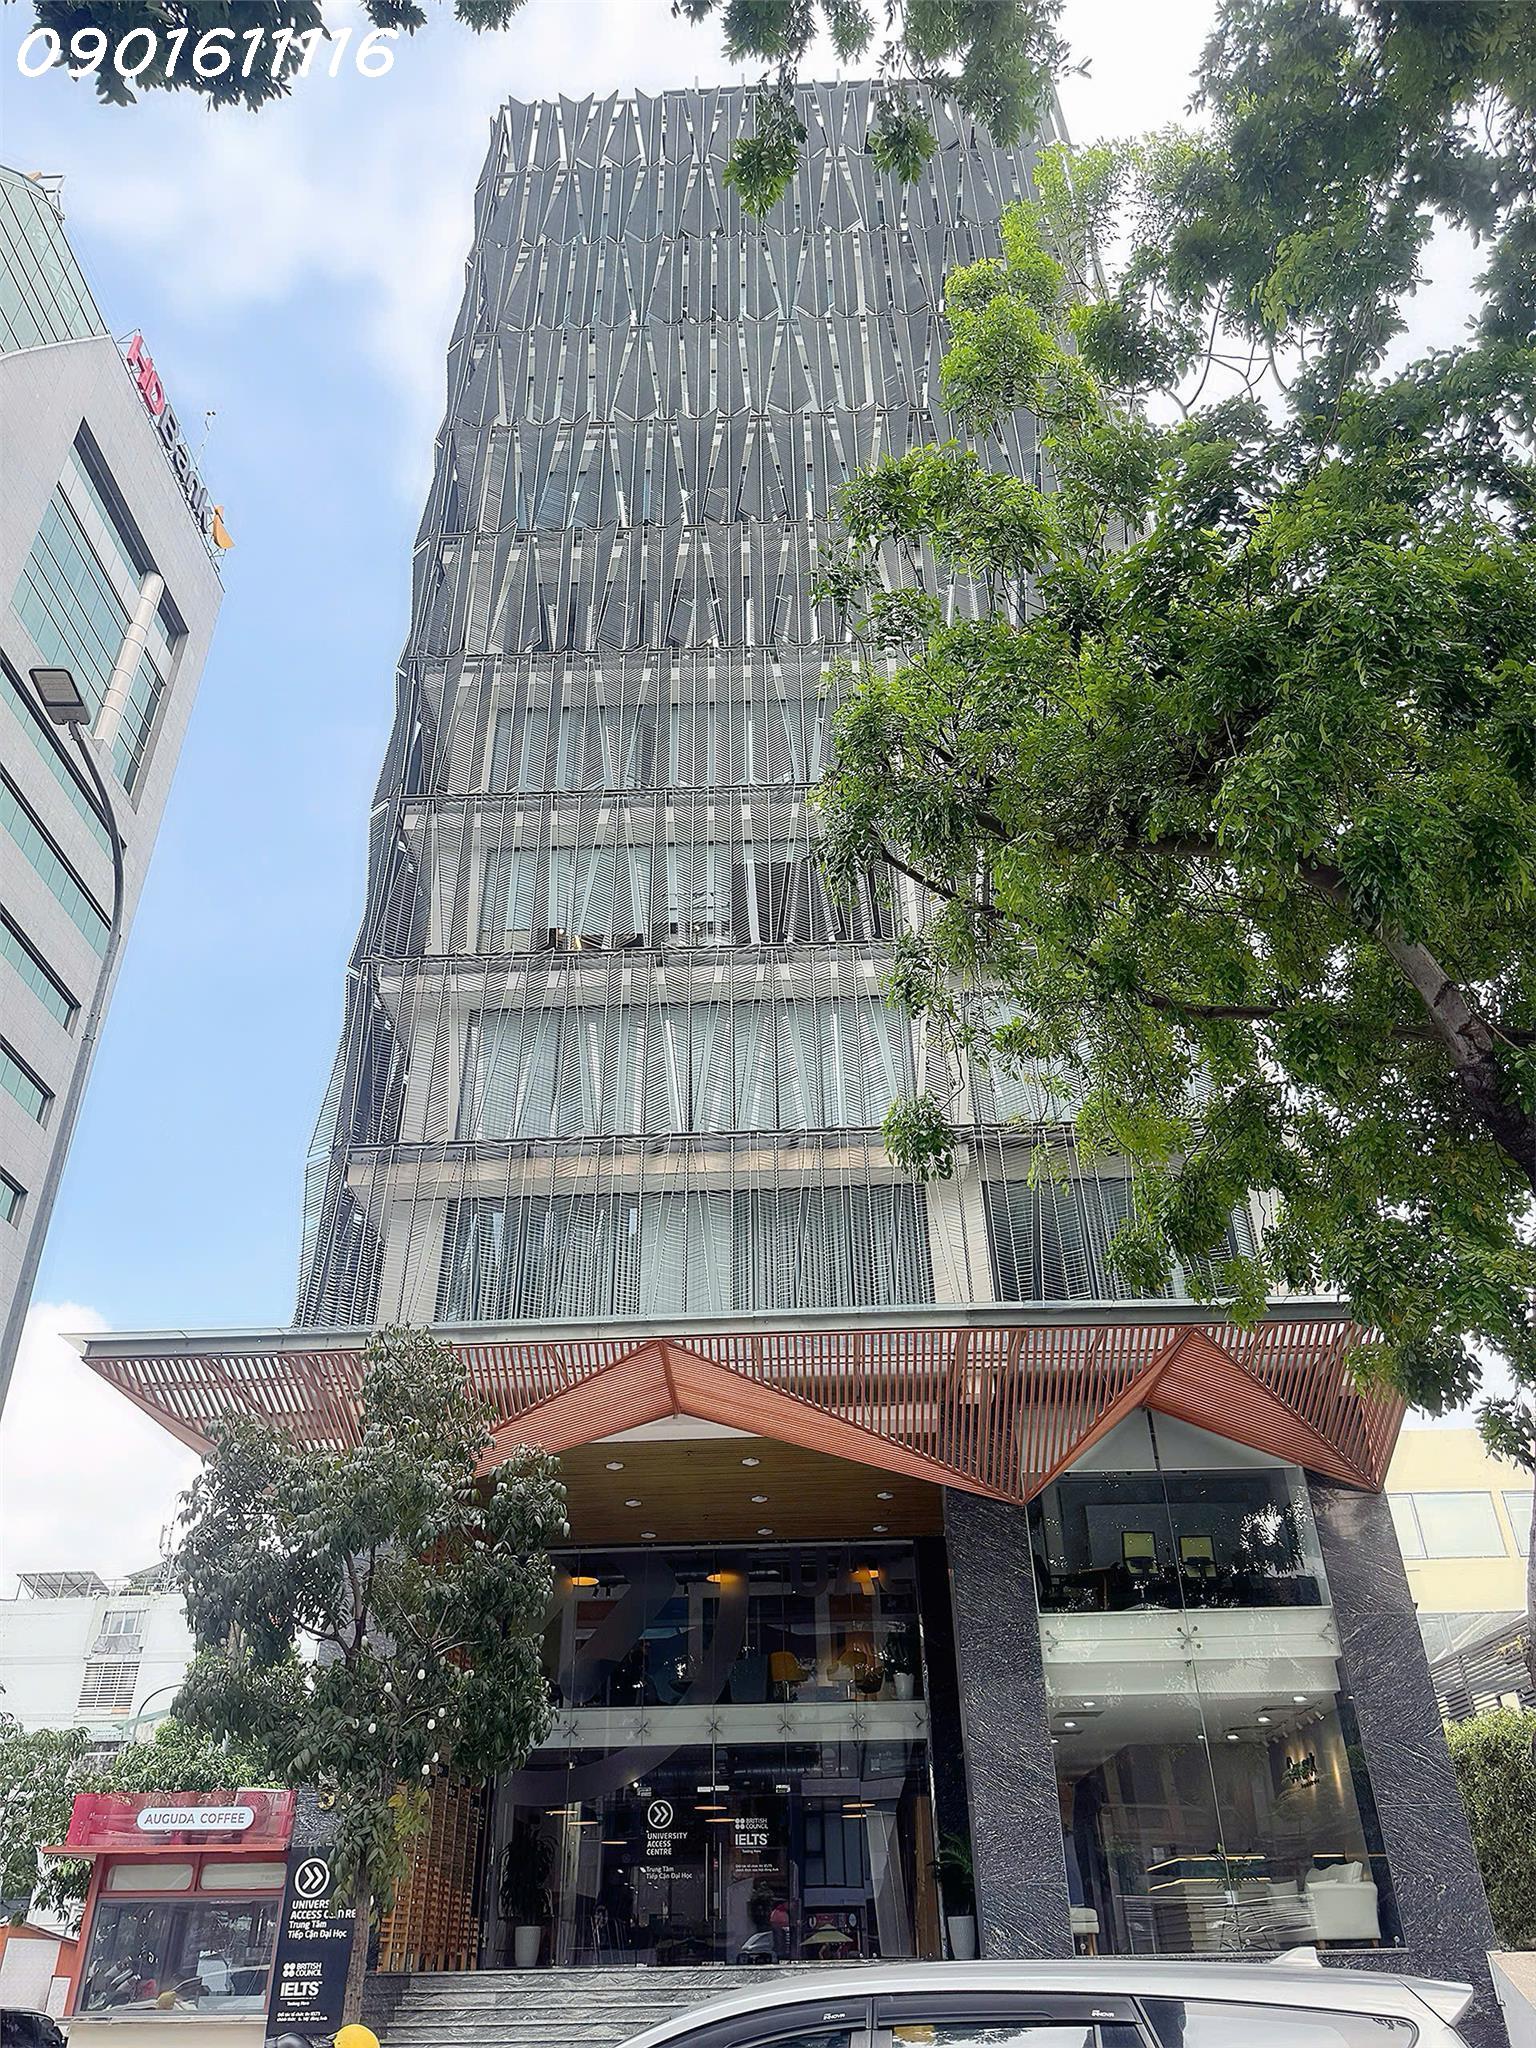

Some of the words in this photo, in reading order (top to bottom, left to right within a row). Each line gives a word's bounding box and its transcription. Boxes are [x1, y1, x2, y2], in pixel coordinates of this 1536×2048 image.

[144, 1814, 195, 1824] AUGUDA
[200, 1813, 246, 1824] COFFEE
[647, 1832, 688, 1840] UNIVERSITY
[735, 1834, 767, 1845] IELTS
[647, 1840, 671, 1848] ACCESS
[646, 1848, 672, 1856] CENTRE
[290, 1910, 322, 1920] ACCESS
[289, 1920, 310, 1930] Trung
[280, 1982, 320, 1997] IELTS
